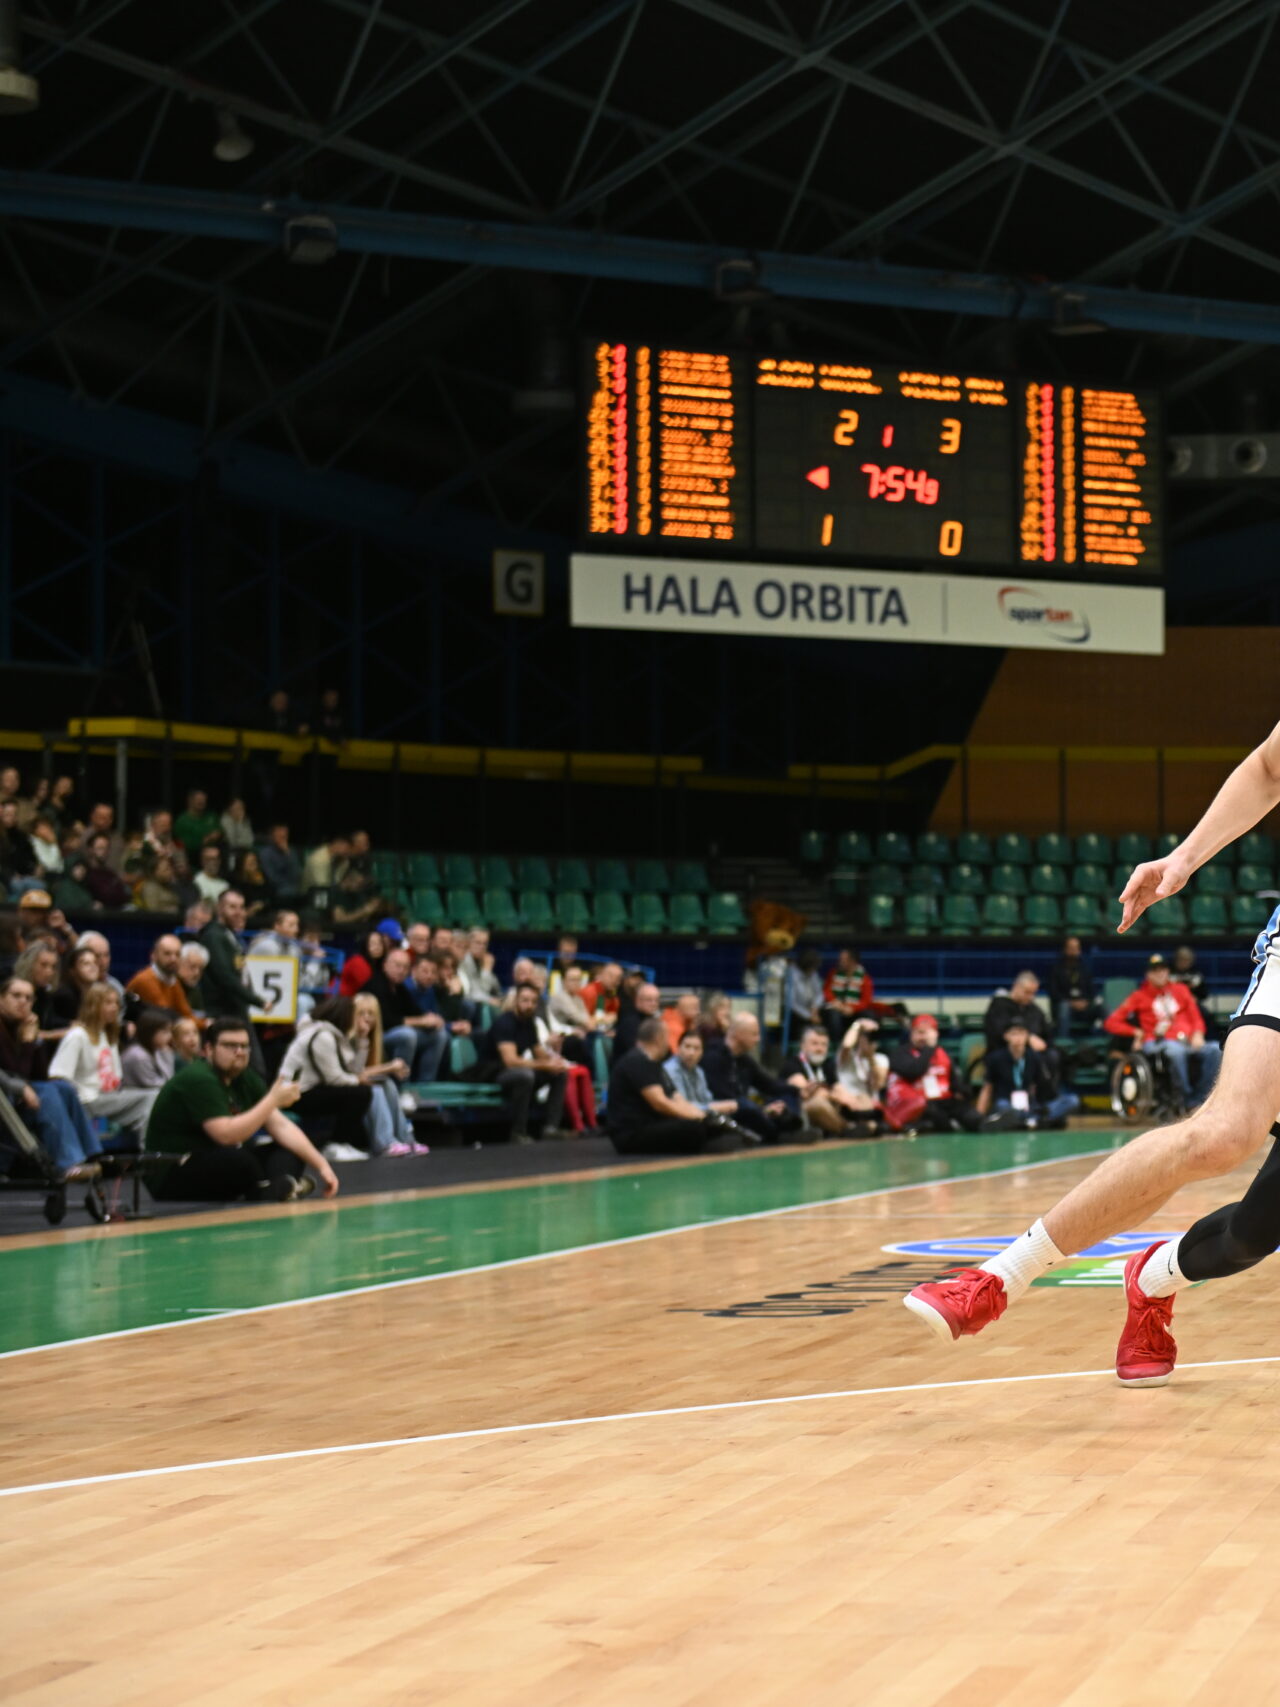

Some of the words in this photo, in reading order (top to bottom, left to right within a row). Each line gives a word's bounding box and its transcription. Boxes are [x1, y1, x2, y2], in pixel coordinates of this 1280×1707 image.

[833, 409, 859, 446] 2
[939, 418, 962, 454] 3
[821, 514, 834, 546] 1
[939, 520, 963, 556] 0
[505, 560, 534, 606] G
[623, 572, 741, 618] HALA
[754, 580, 909, 627] ORBITA
[263, 972, 282, 1006] 5
